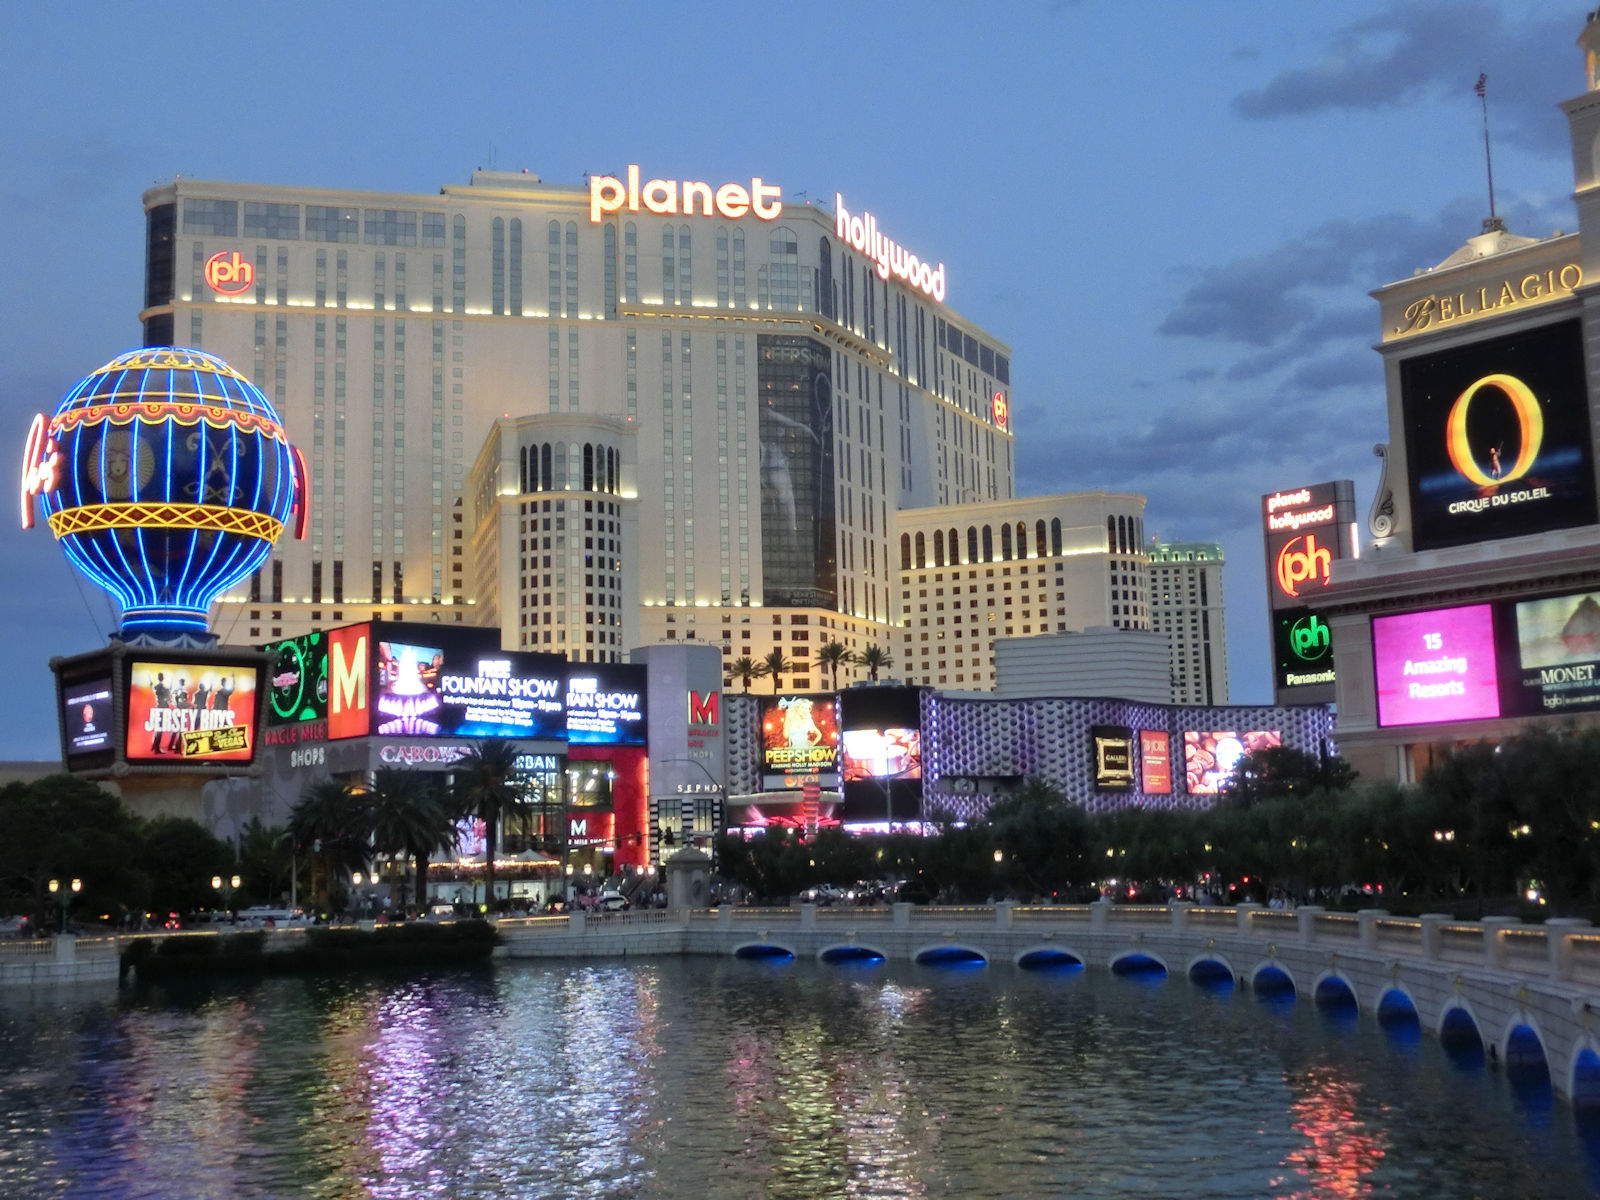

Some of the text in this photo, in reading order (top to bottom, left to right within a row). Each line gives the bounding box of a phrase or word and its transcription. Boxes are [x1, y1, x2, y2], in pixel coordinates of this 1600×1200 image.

[589, 164, 783, 223] planet
[835, 192, 946, 302] hollywood
[209, 251, 253, 287] ph
[1394, 263, 1584, 335] BELLAGIO
[1446, 373, 1544, 487] O
[1268, 489, 1311, 513] planet
[1448, 487, 1551, 514] CIRQUE DU SOLEIL
[1269, 504, 1333, 530] hollywood
[1283, 534, 1332, 594] ph
[1294, 615, 1330, 656] ph
[1422, 632, 1443, 650] 15
[332, 636, 366, 714] M
[1403, 656, 1467, 676] Amazing
[1541, 664, 1595, 684] MONET
[441, 676, 558, 698] FOUNTAIN SHOW
[1286, 669, 1336, 686] Panasonic
[1409, 680, 1465, 698] Resorts
[594, 693, 638, 709] SHOW
[688, 690, 719, 725] M
[145, 707, 235, 732] JERSEY BOYS
[218, 736, 245, 748] VEGAS
[301, 722, 325, 740] MILE
[291, 746, 324, 767] SHOPS
[379, 745, 439, 766] CABO
[513, 755, 556, 769] RBAN
[765, 748, 837, 763] PEEPSHOW
[570, 819, 587, 836] M
